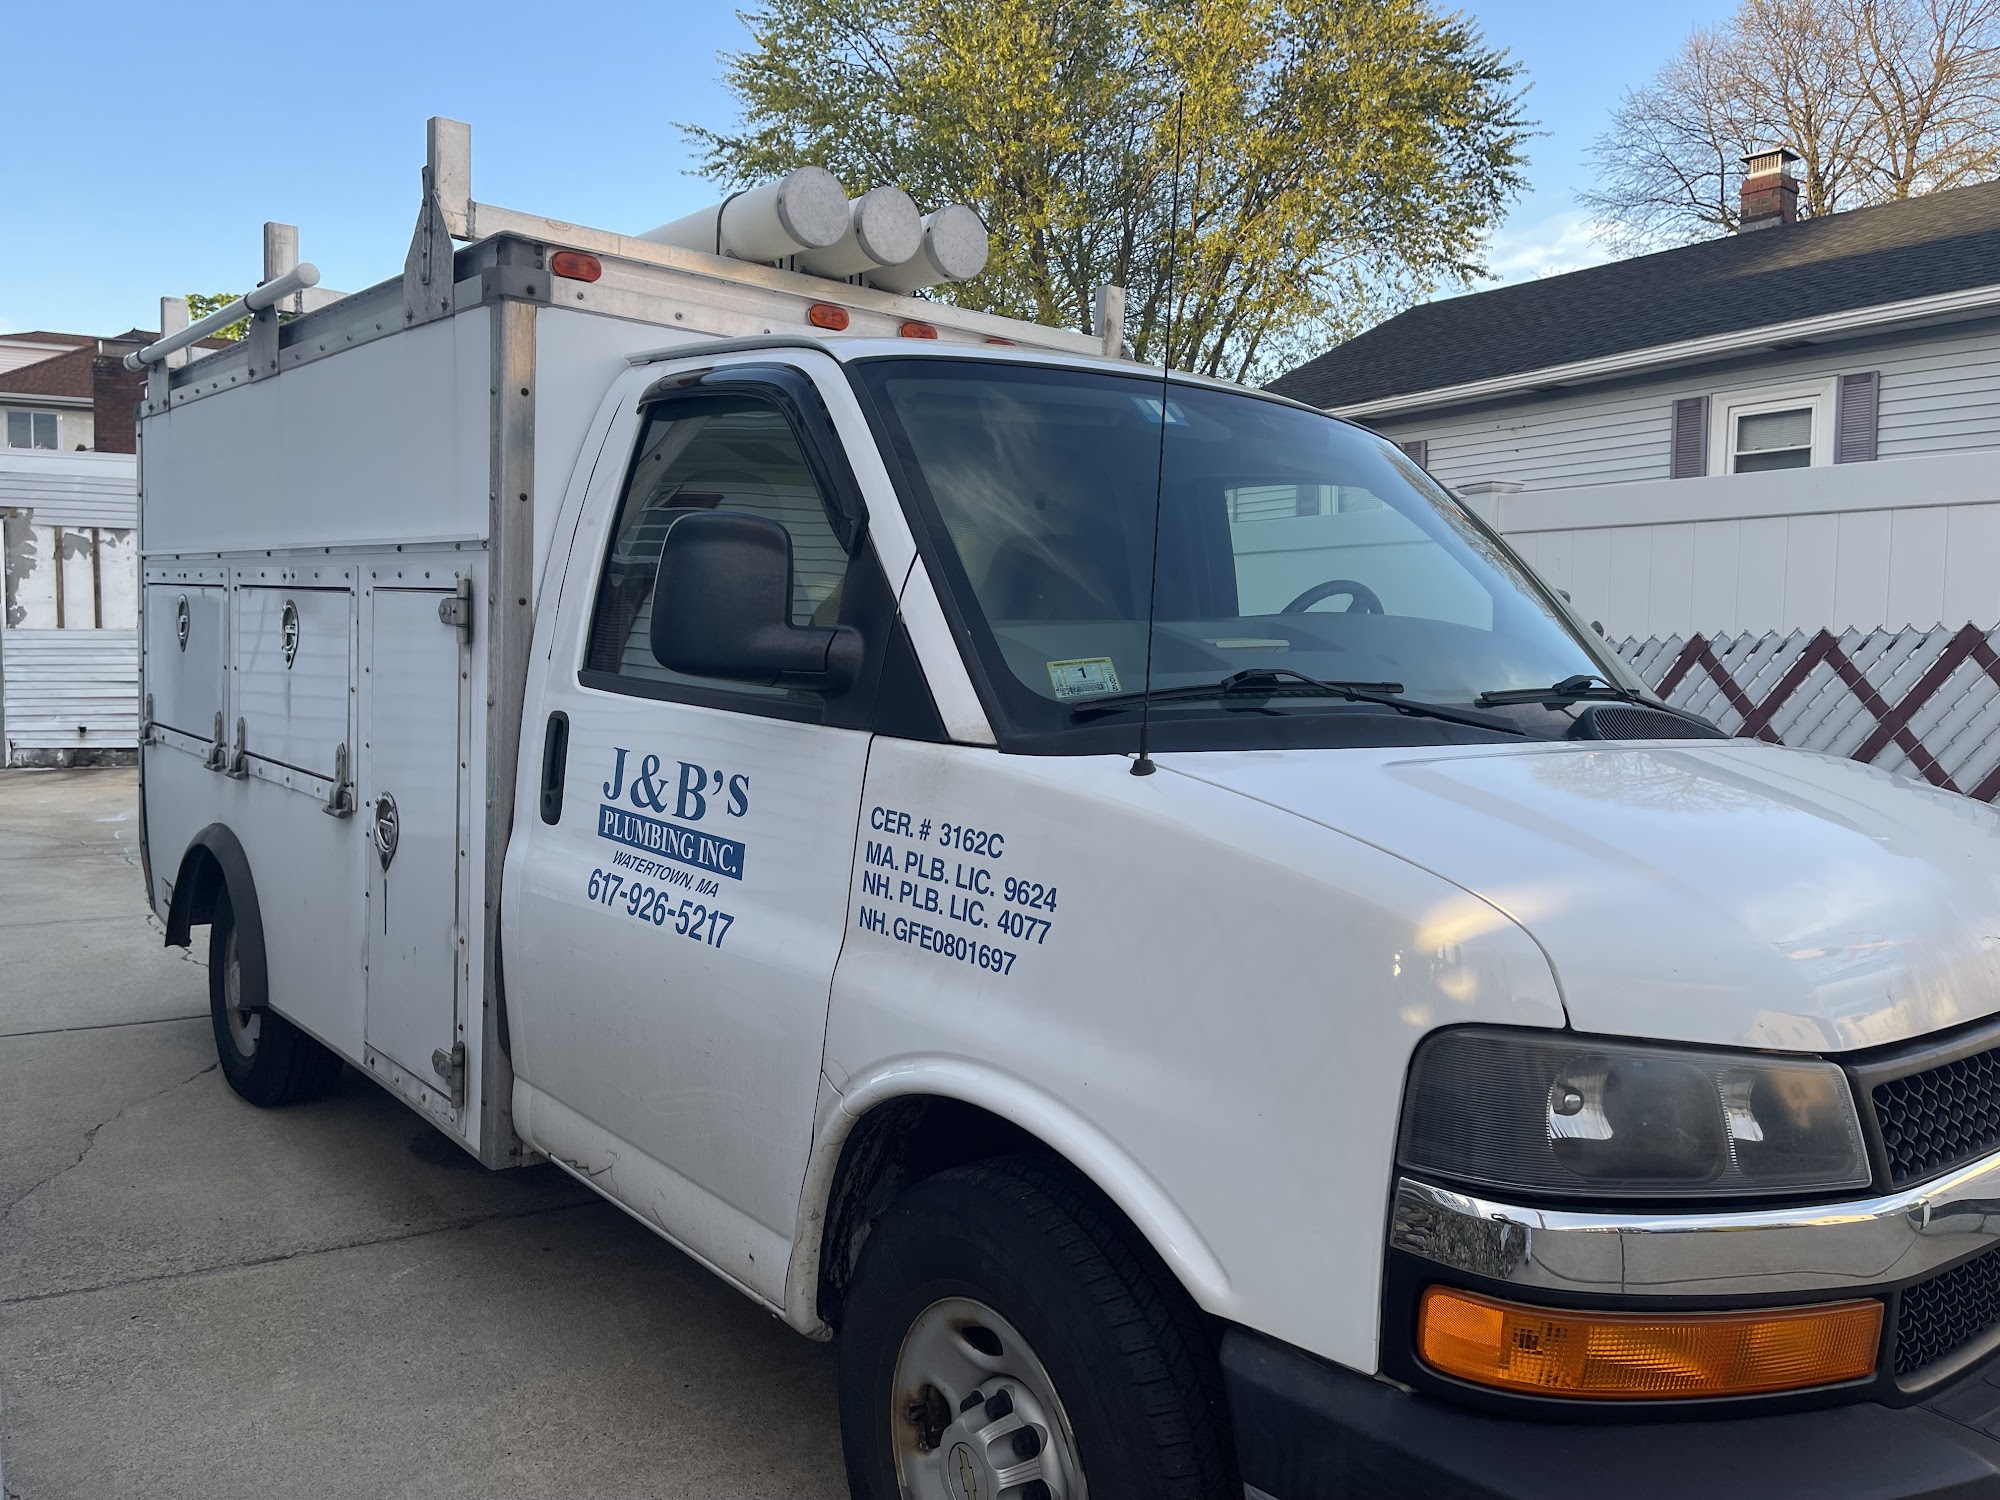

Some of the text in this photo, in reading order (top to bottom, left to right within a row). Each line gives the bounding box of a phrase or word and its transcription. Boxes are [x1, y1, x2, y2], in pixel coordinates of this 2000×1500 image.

[1078, 667, 1087, 679] 1
[603, 810, 737, 874] PLUMBING INC.
[871, 807, 1005, 858] CER. # 3162C
[612, 850, 720, 898] WATERTOWN, MA
[865, 841, 1057, 912] MA. PLB. LIC. 9624
[588, 868, 735, 948] 617-926-5217
[863, 870, 1051, 944] NH. PLB. LIC. 4077
